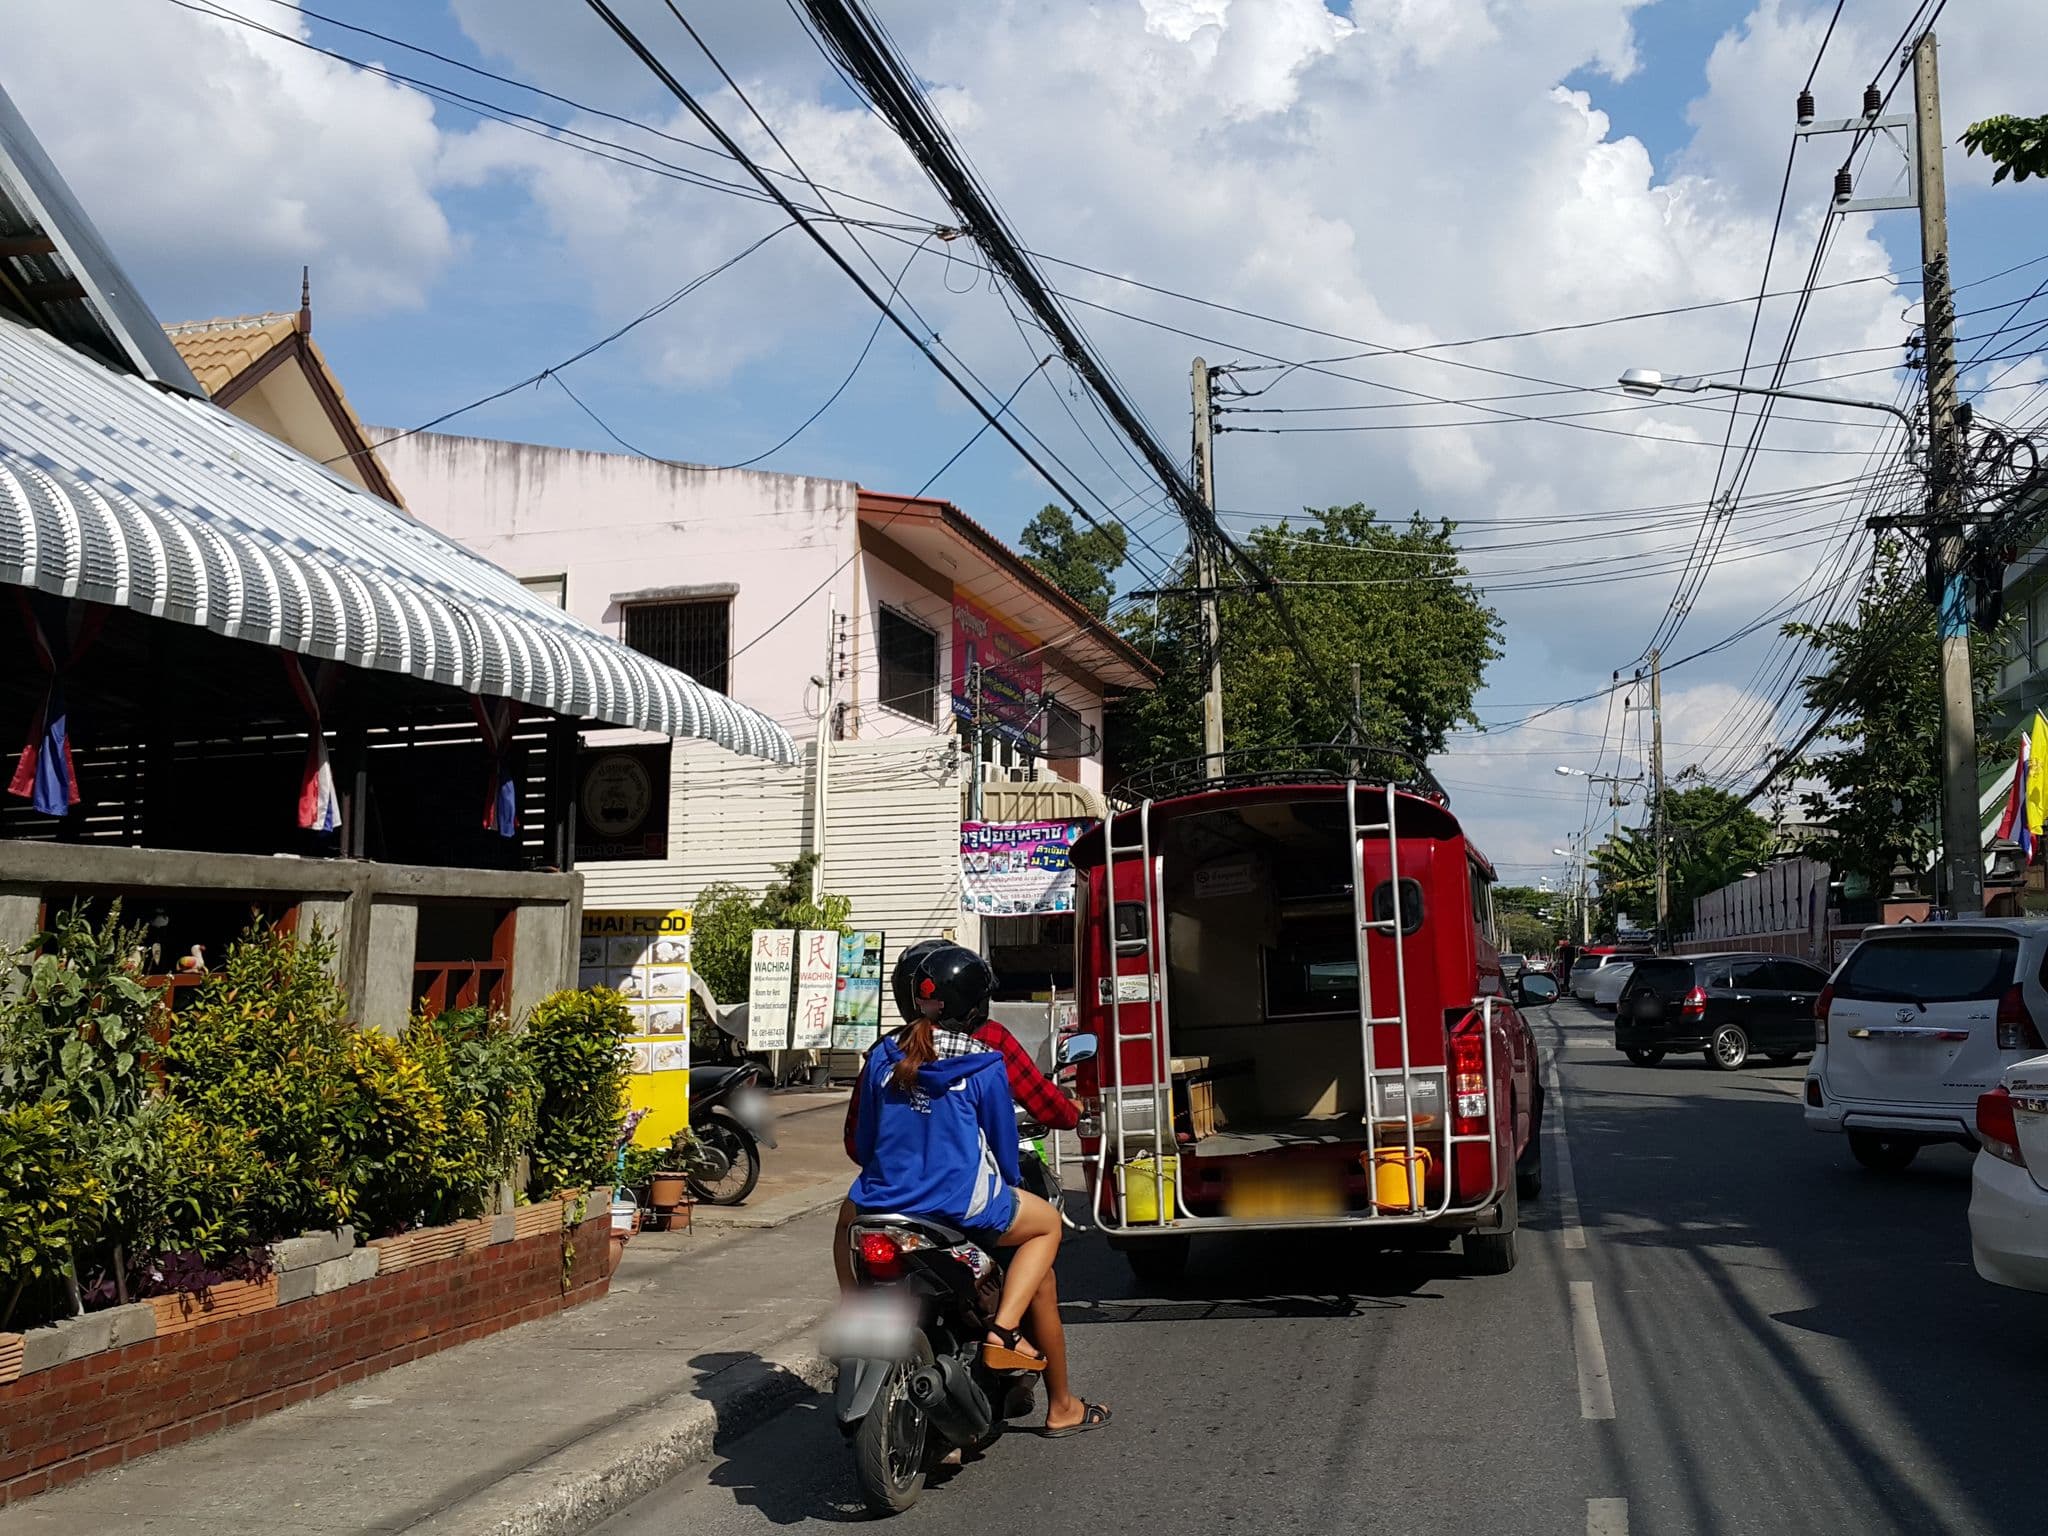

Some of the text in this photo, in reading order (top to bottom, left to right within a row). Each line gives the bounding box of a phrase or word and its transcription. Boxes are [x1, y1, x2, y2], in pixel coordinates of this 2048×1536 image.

[633, 916, 686, 931] FOOD
[807, 934, 831, 970] 民
[754, 961, 790, 973] WACHIRA
[800, 972, 833, 981] WACHIRA
[802, 993, 828, 1030] 宿
